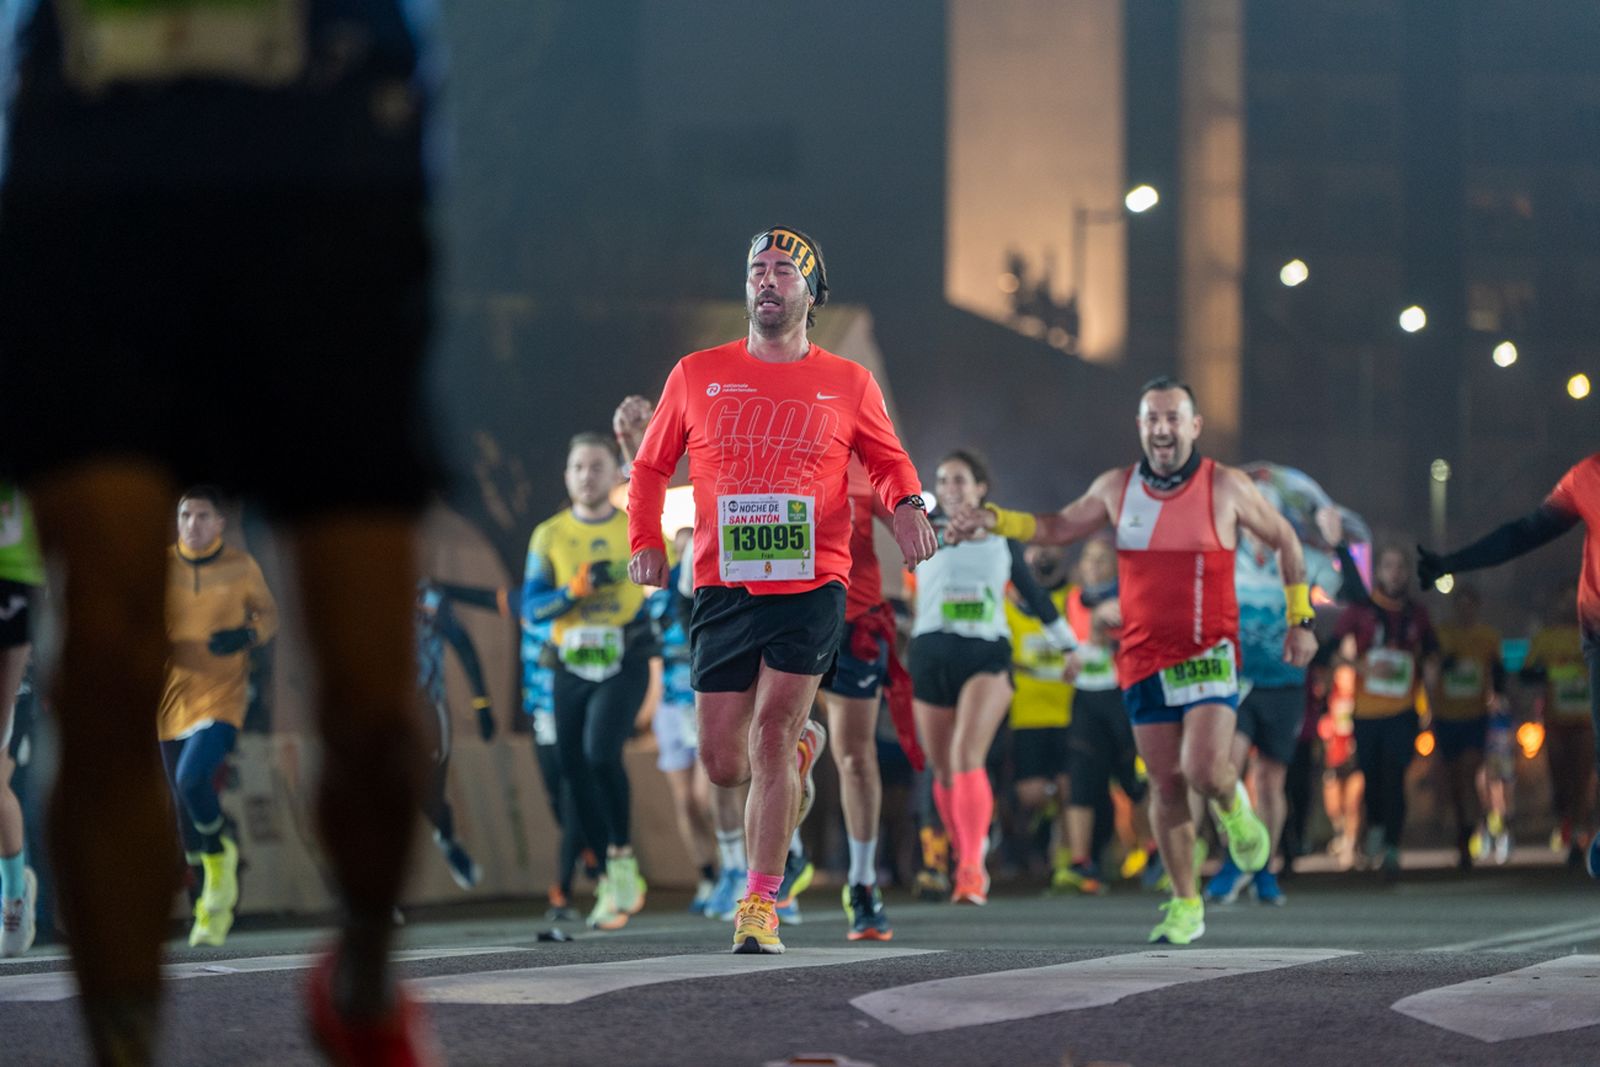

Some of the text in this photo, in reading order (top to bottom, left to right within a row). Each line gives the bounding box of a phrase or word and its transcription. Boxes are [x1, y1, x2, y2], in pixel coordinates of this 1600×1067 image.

[705, 396, 839, 453] GOOD
[739, 504, 779, 513] NOCHE DE
[729, 516, 748, 524] SAN
[749, 514, 780, 524] ANTÓN
[730, 526, 804, 551] 13095
